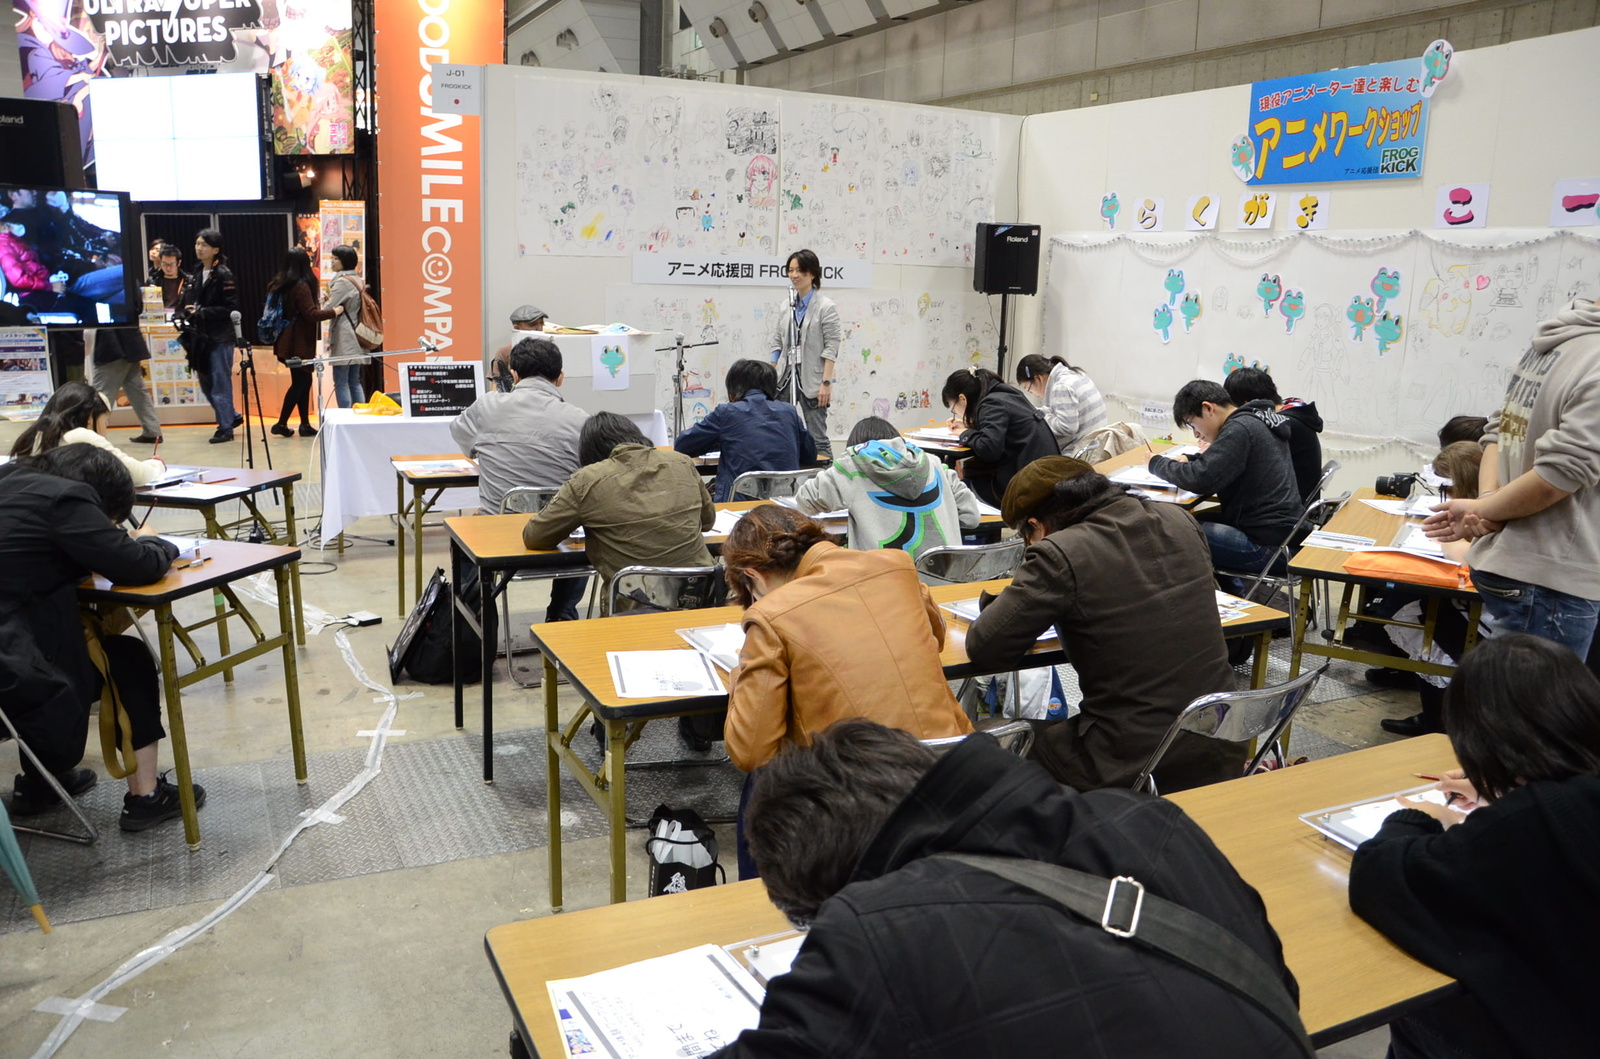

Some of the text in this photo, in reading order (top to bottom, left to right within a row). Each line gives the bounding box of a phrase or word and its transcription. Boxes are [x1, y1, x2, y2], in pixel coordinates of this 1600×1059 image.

[104, 16, 229, 46] PICTURES
[446, 69, 465, 77] J-01
[1258, 76, 1421, 112] 現役アニメーター達と楽しむ
[0, 114, 24, 124] land
[1253, 99, 1423, 180] アニメワークショップ
[1380, 146, 1420, 164] FROG
[1343, 166, 1379, 175] アニメ応援団
[1379, 157, 1419, 175] KICK
[1006, 235, 1029, 243] Roland
[667, 261, 845, 280] アニメ応援団 FROICK
[666, 1023, 704, 1059] 間まで
